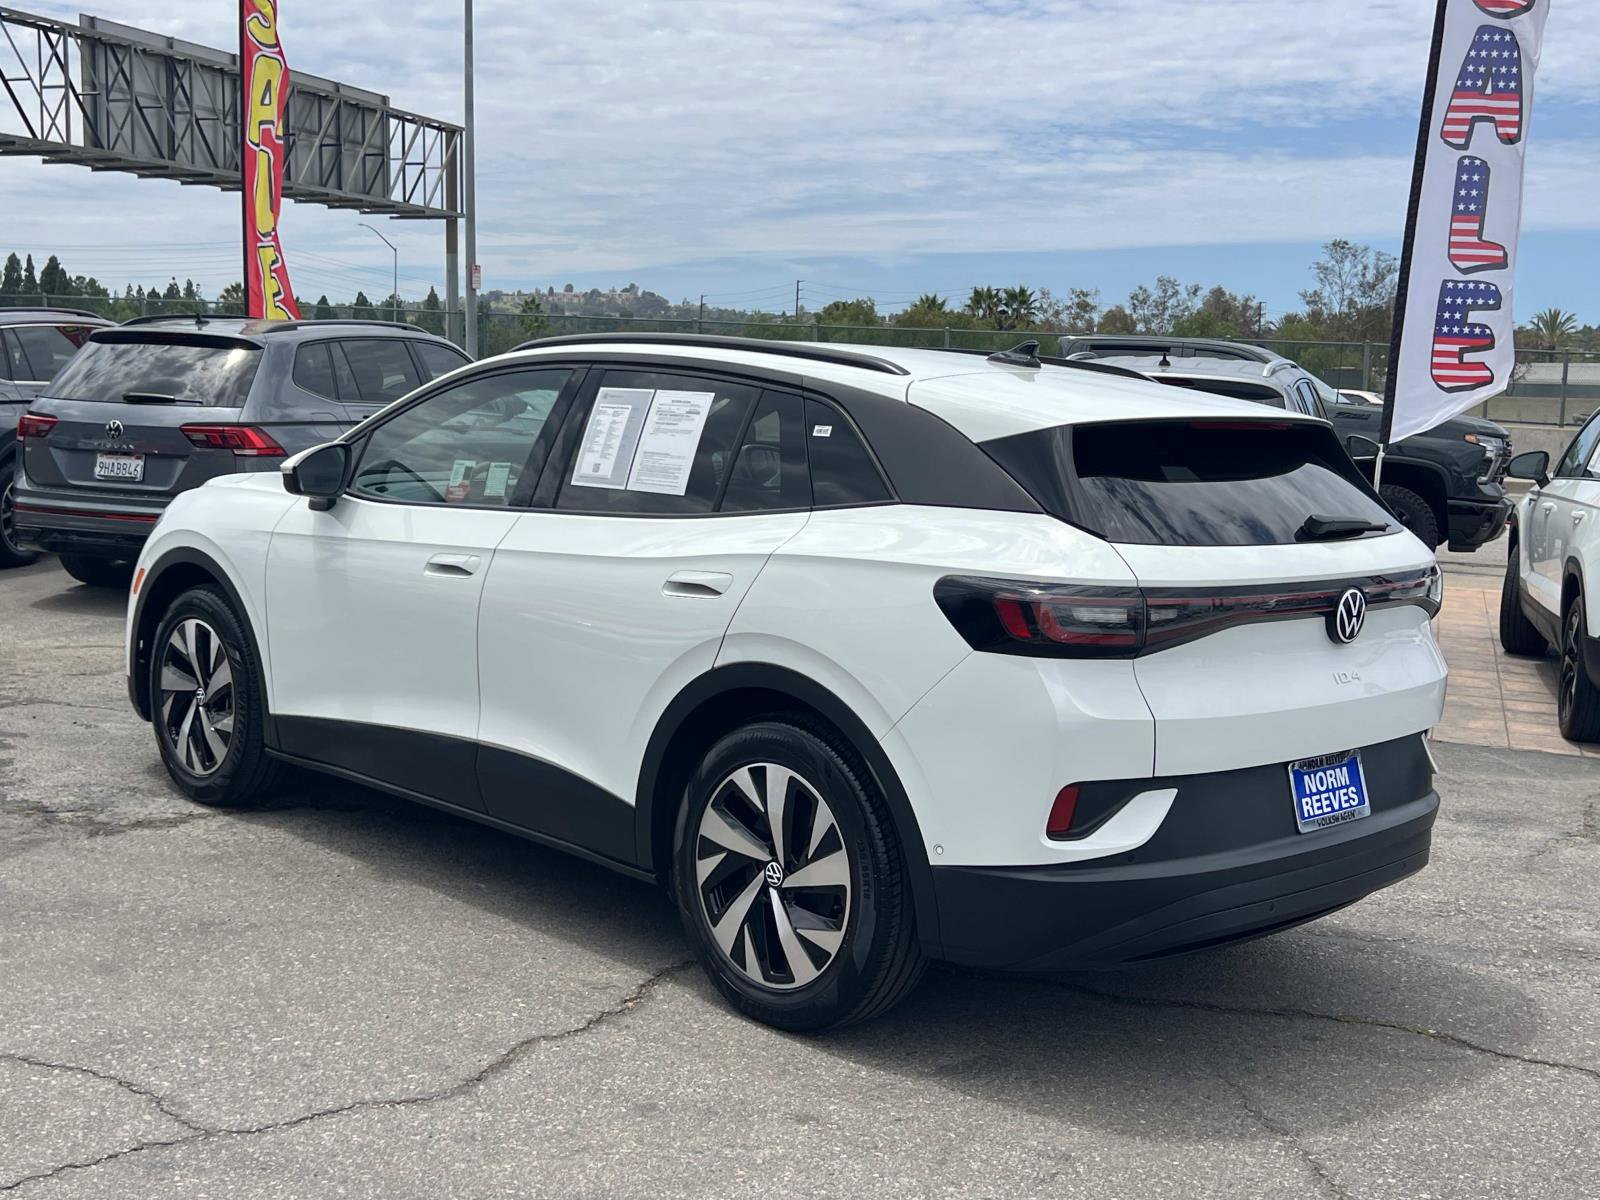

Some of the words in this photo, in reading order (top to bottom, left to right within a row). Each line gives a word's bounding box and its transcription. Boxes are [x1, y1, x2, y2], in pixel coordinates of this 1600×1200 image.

[1431, 0, 1535, 393] ALE
[1303, 766, 1350, 795] NORM
[1301, 786, 1359, 818] REEVES
